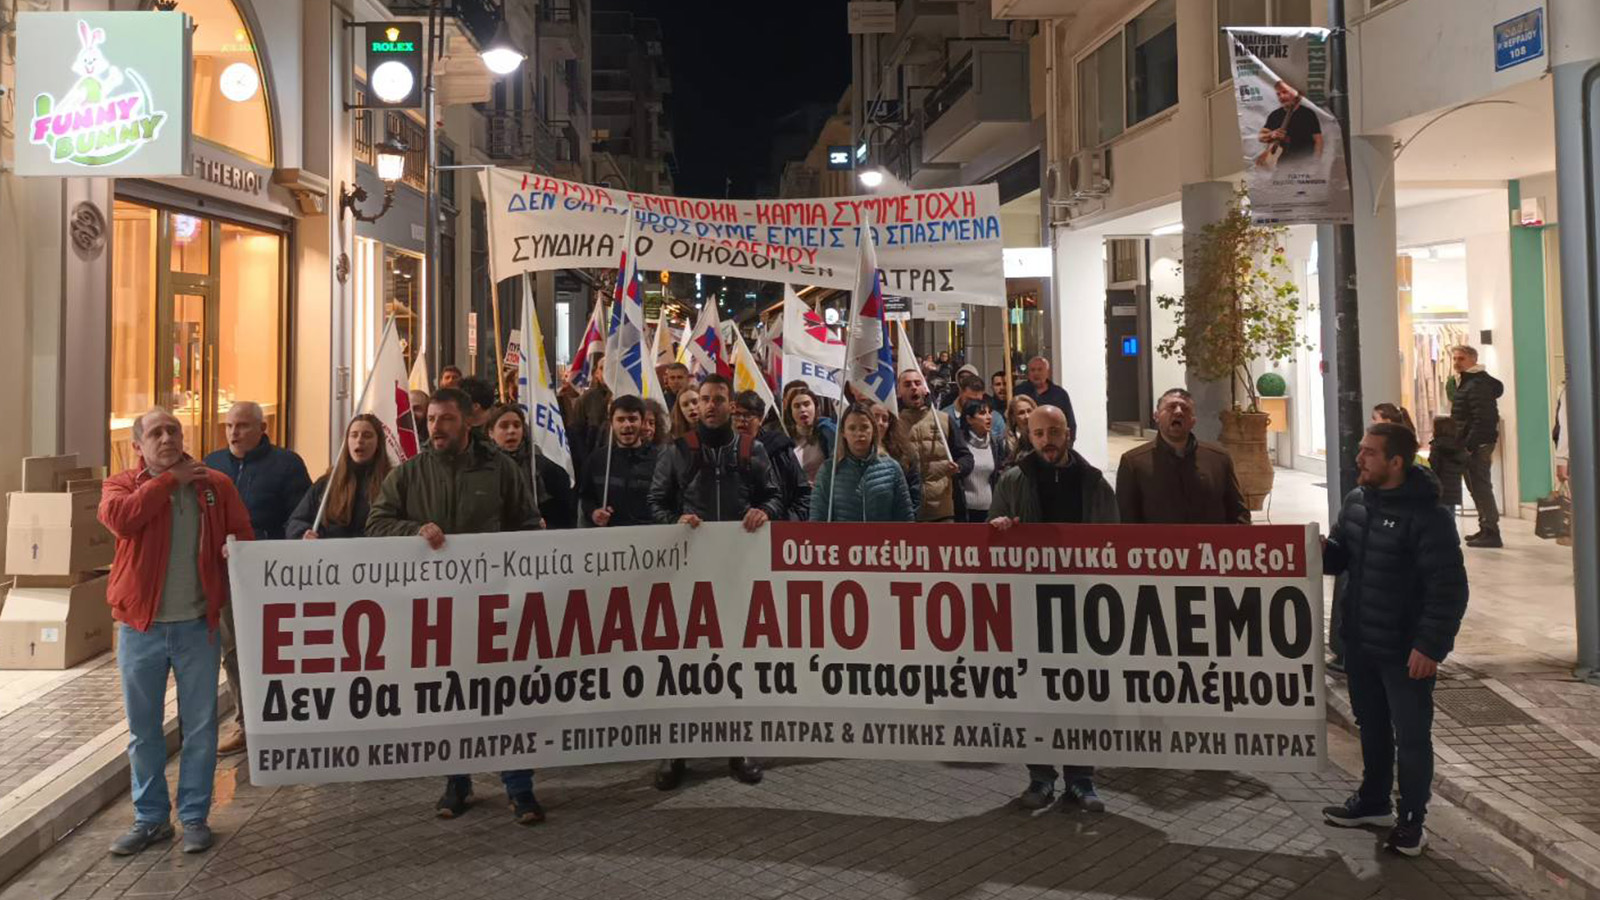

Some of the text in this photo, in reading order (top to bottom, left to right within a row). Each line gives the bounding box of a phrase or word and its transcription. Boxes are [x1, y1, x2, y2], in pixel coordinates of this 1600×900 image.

[372, 42, 415, 52] ROLEX
[1510, 45, 1528, 59] 108
[33, 96, 139, 140] FUNNY
[54, 114, 164, 160] BUNNY
[508, 192, 556, 213] ΔΕΝ
[767, 226, 845, 248] ΕΜΕΙΣ
[885, 215, 1000, 245] ΣΠΑΣΜΕΝΑ
[756, 203, 828, 226] ΚΑΜΙΑ
[832, 190, 977, 227] ΣΥΜΜΕΤΟΧΗ
[511, 234, 654, 263] ΣΥΝΔΙΚΑΟ
[880, 268, 954, 292] ΑΤΡΑΣ
[264, 559, 341, 591] Καμία
[584, 541, 689, 577] εμπλοκή!
[782, 539, 1295, 575] Ούτε σκέψη για πυρηνικά στον Άραξο!
[261, 579, 1313, 676] ΕΞΩ Η ΕΛΛΑΔΑ ΑΠΟ ΤΟΝ ΠΟΛΕΜΟ
[262, 679, 336, 723] Δεν
[350, 676, 402, 720] θα
[414, 664, 612, 717] πληρώσει
[622, 664, 645, 698] ο
[656, 654, 743, 699] λαός
[754, 661, 797, 695] τα
[1041, 667, 1110, 702] του
[1123, 661, 1316, 712] πολέμου!
[258, 745, 360, 771] ΕΡΓΑΤΙΚΟ
[368, 739, 450, 767] ΚΕΝΤΡΟ
[459, 732, 537, 760] ΠΑΤΡΑΣ
[562, 723, 662, 751] ΕΠΙΤΡΟΠΗ
[669, 720, 753, 744] ΕΙΡΗΝΗΣ
[761, 721, 834, 744] ΠΑΤΡΑΣ
[841, 722, 855, 744] &
[862, 723, 946, 746] ΔΥΤΙΚΗΣ
[953, 722, 1027, 749] ΑΧΑΪΑΣ
[1052, 727, 1162, 753] ΔΗΜΟΤΙΚΗ
[1170, 731, 1227, 755] ΑΡΧΗ
[1235, 733, 1317, 757] ΠΑΤΡΑΣ
